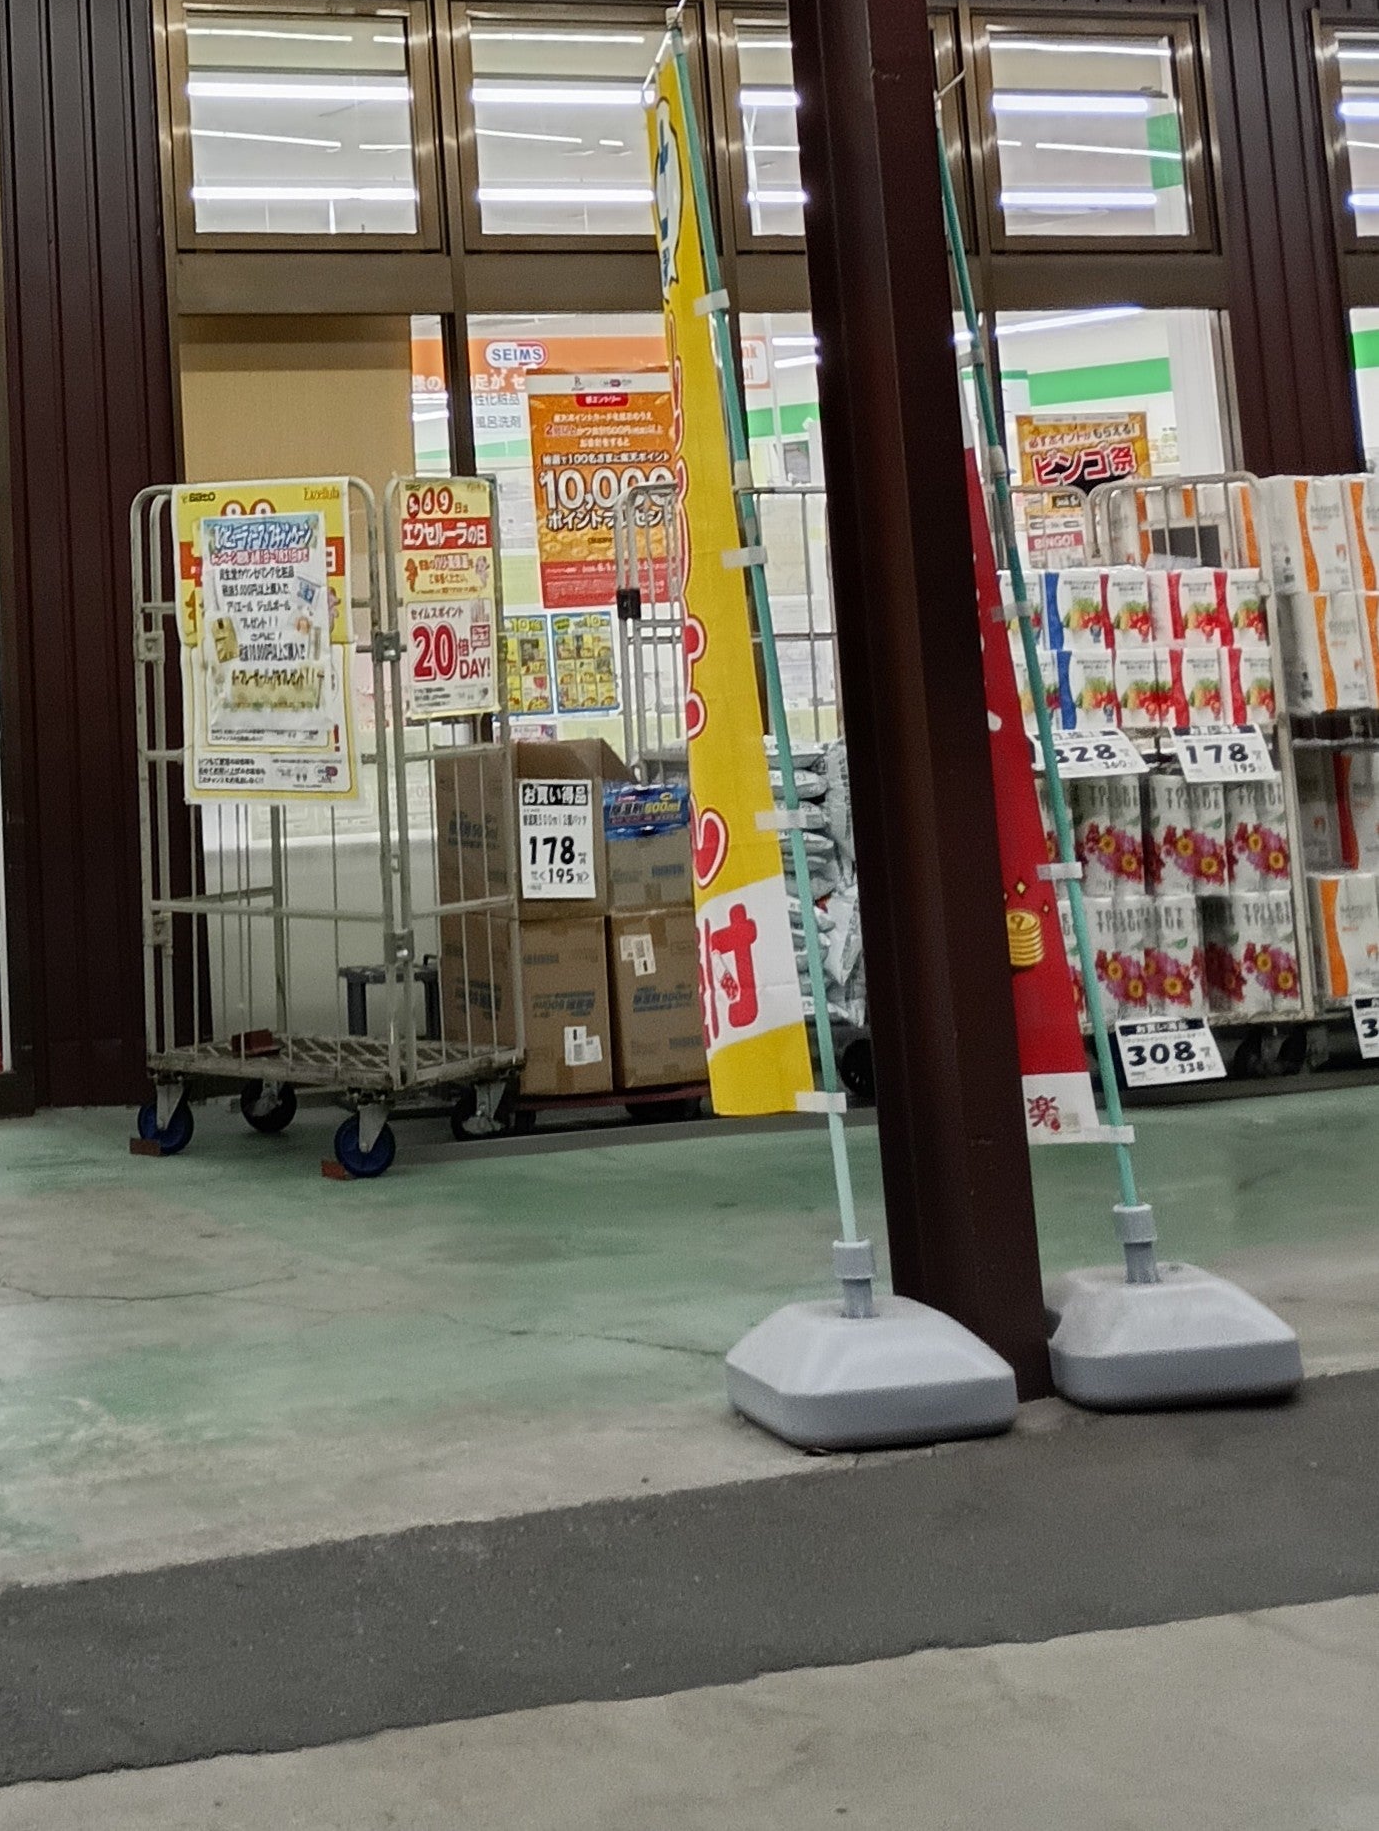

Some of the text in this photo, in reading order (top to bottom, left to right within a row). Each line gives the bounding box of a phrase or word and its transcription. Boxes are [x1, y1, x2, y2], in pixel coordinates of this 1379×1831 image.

[492, 348, 542, 362] SEIMS
[410, 607, 464, 620] セイムスポイント
[412, 623, 457, 680] 20
[459, 656, 491, 679] DAY!
[1186, 743, 1249, 763] 178
[524, 785, 588, 805] お買い得品
[529, 836, 575, 865] 178
[1127, 1041, 1196, 1067] 308
